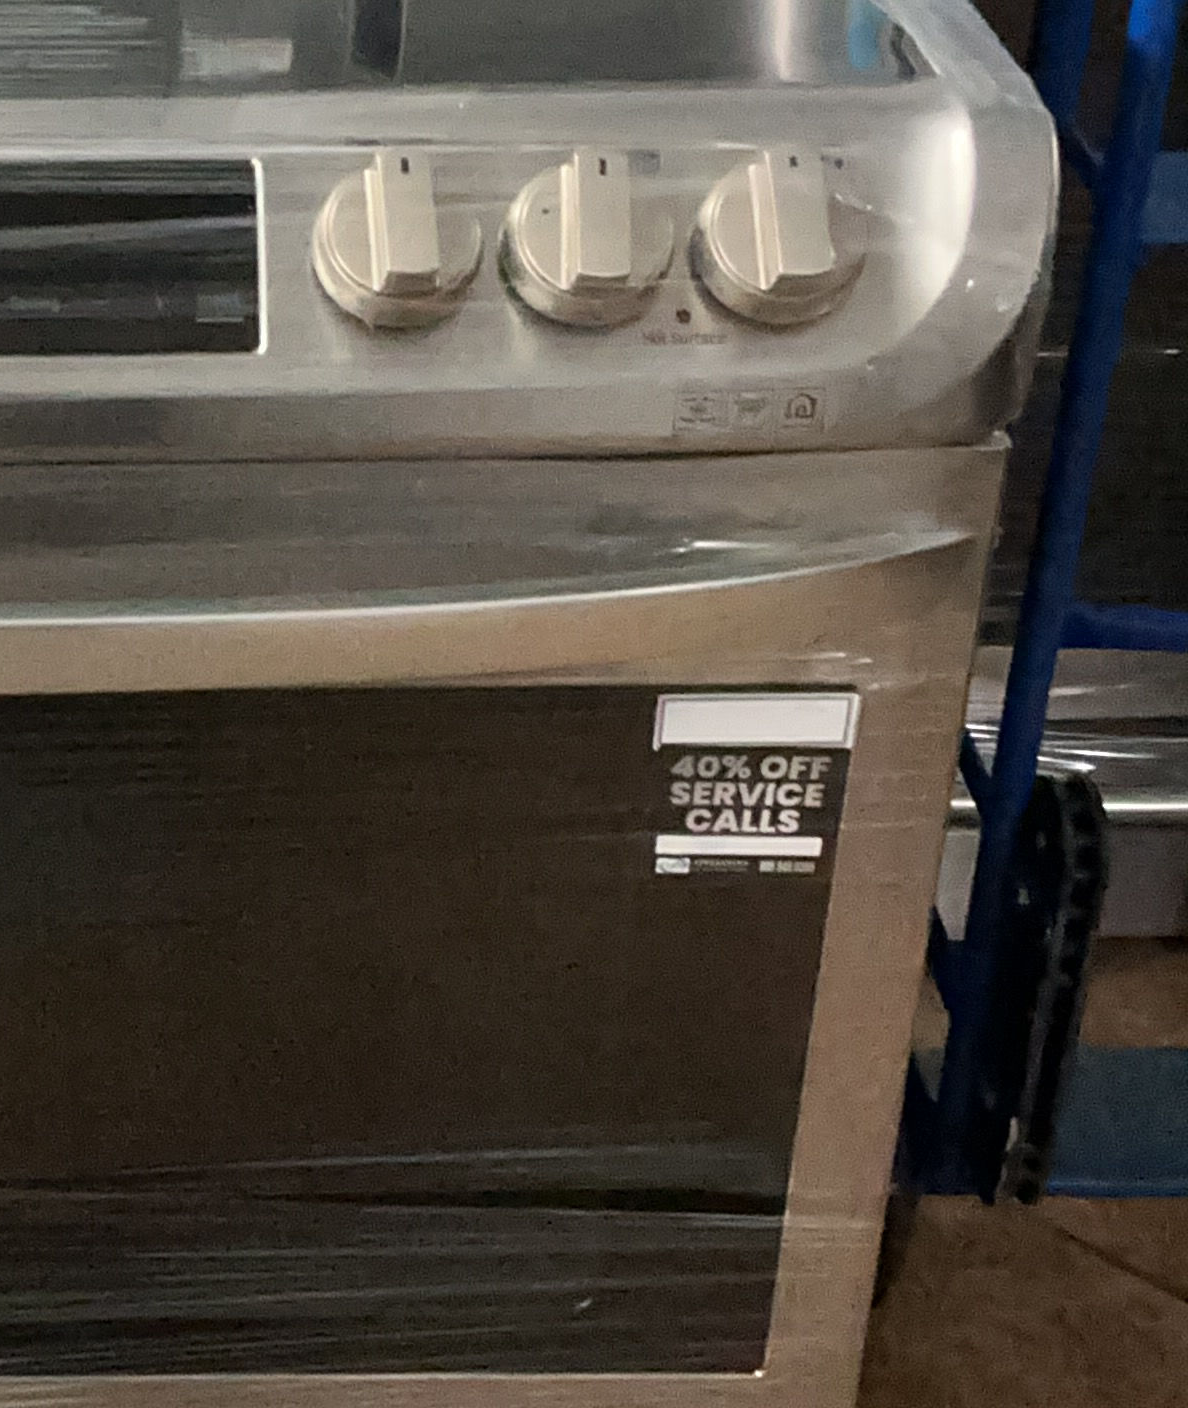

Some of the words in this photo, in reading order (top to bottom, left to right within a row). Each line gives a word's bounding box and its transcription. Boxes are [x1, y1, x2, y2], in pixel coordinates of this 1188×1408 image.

[670, 755, 752, 779] 40%
[760, 755, 832, 780] OFF
[669, 782, 825, 808] SERVICE
[685, 809, 801, 833] CALLS
